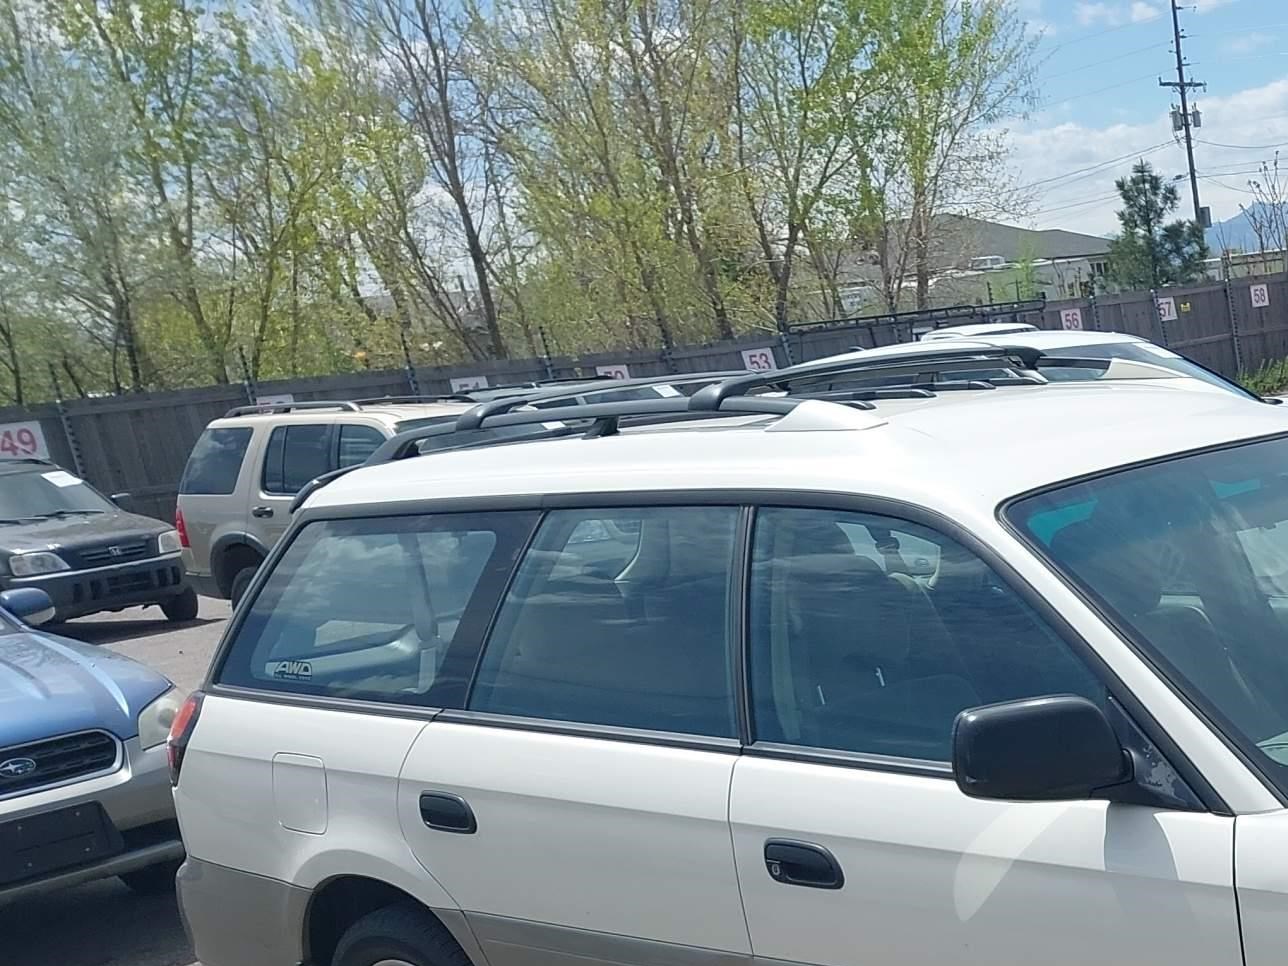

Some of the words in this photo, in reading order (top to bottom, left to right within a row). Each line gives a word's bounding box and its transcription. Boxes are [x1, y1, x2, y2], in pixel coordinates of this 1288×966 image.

[1065, 312, 1079, 329] 56
[749, 353, 771, 369] 53
[1, 428, 37, 456] 49
[275, 660, 312, 675] AWD
